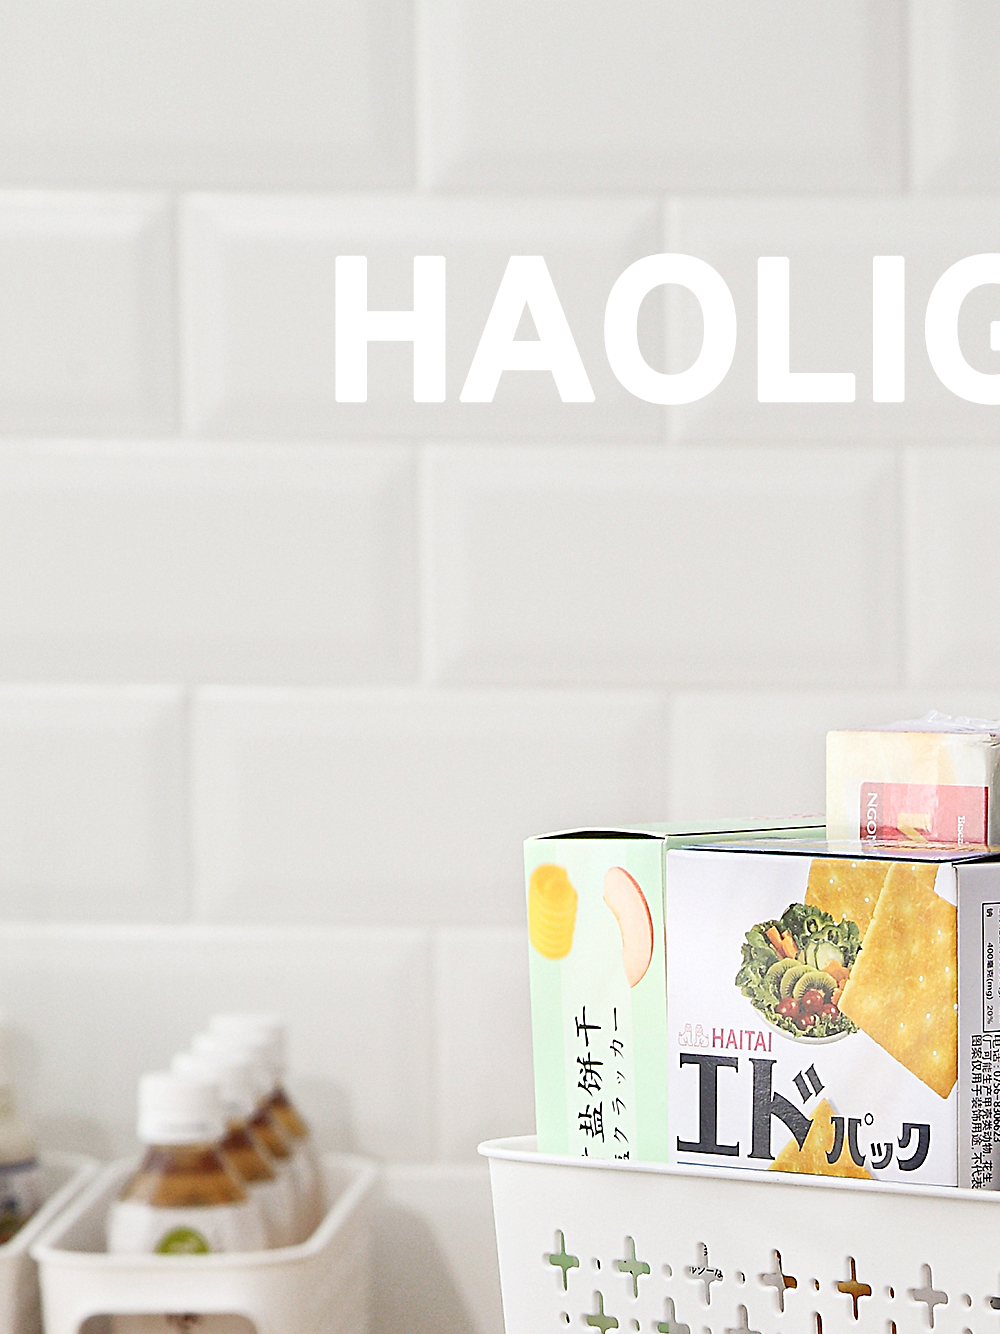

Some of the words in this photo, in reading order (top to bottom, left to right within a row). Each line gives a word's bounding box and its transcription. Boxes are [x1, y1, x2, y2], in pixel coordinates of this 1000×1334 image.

[574, 1005, 605, 1157] 盐饼干
[711, 1028, 773, 1052] HAITAI
